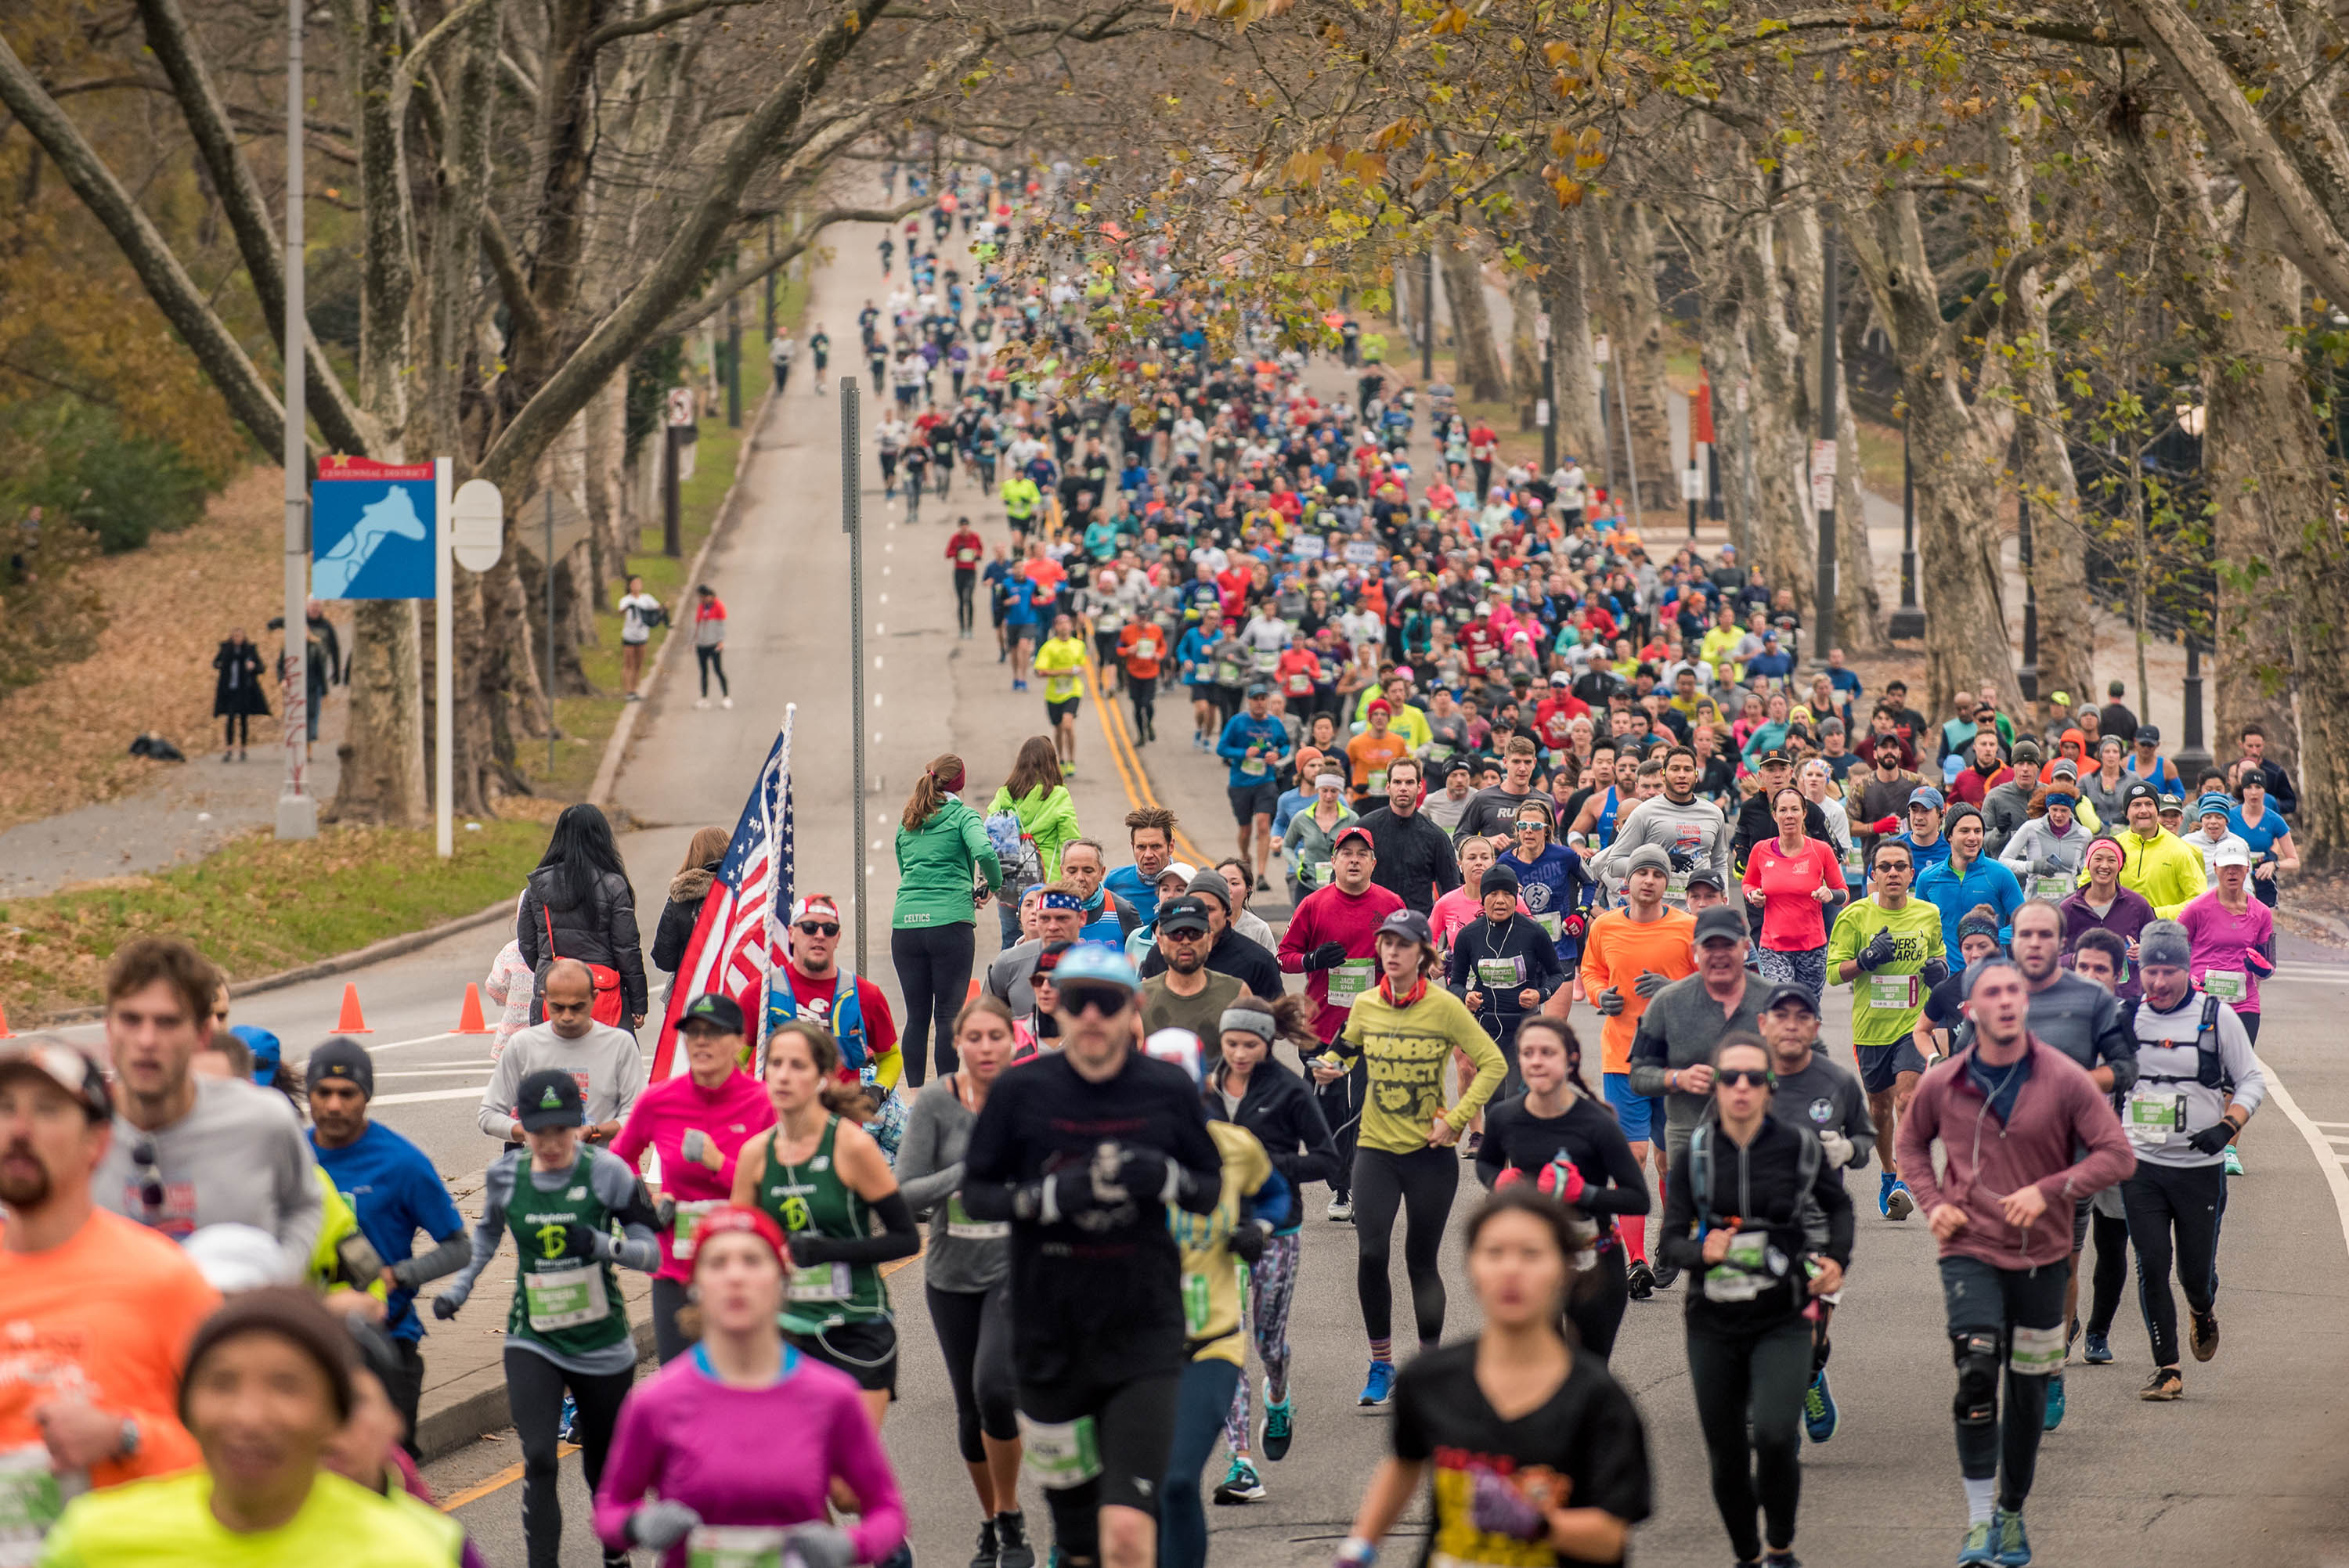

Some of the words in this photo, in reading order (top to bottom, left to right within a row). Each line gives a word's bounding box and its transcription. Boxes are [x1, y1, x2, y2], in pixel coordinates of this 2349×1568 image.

[320, 469, 381, 478] CENTENNIAL
[384, 468, 428, 477] DISTRICT
[904, 913, 930, 923] CELTICS
